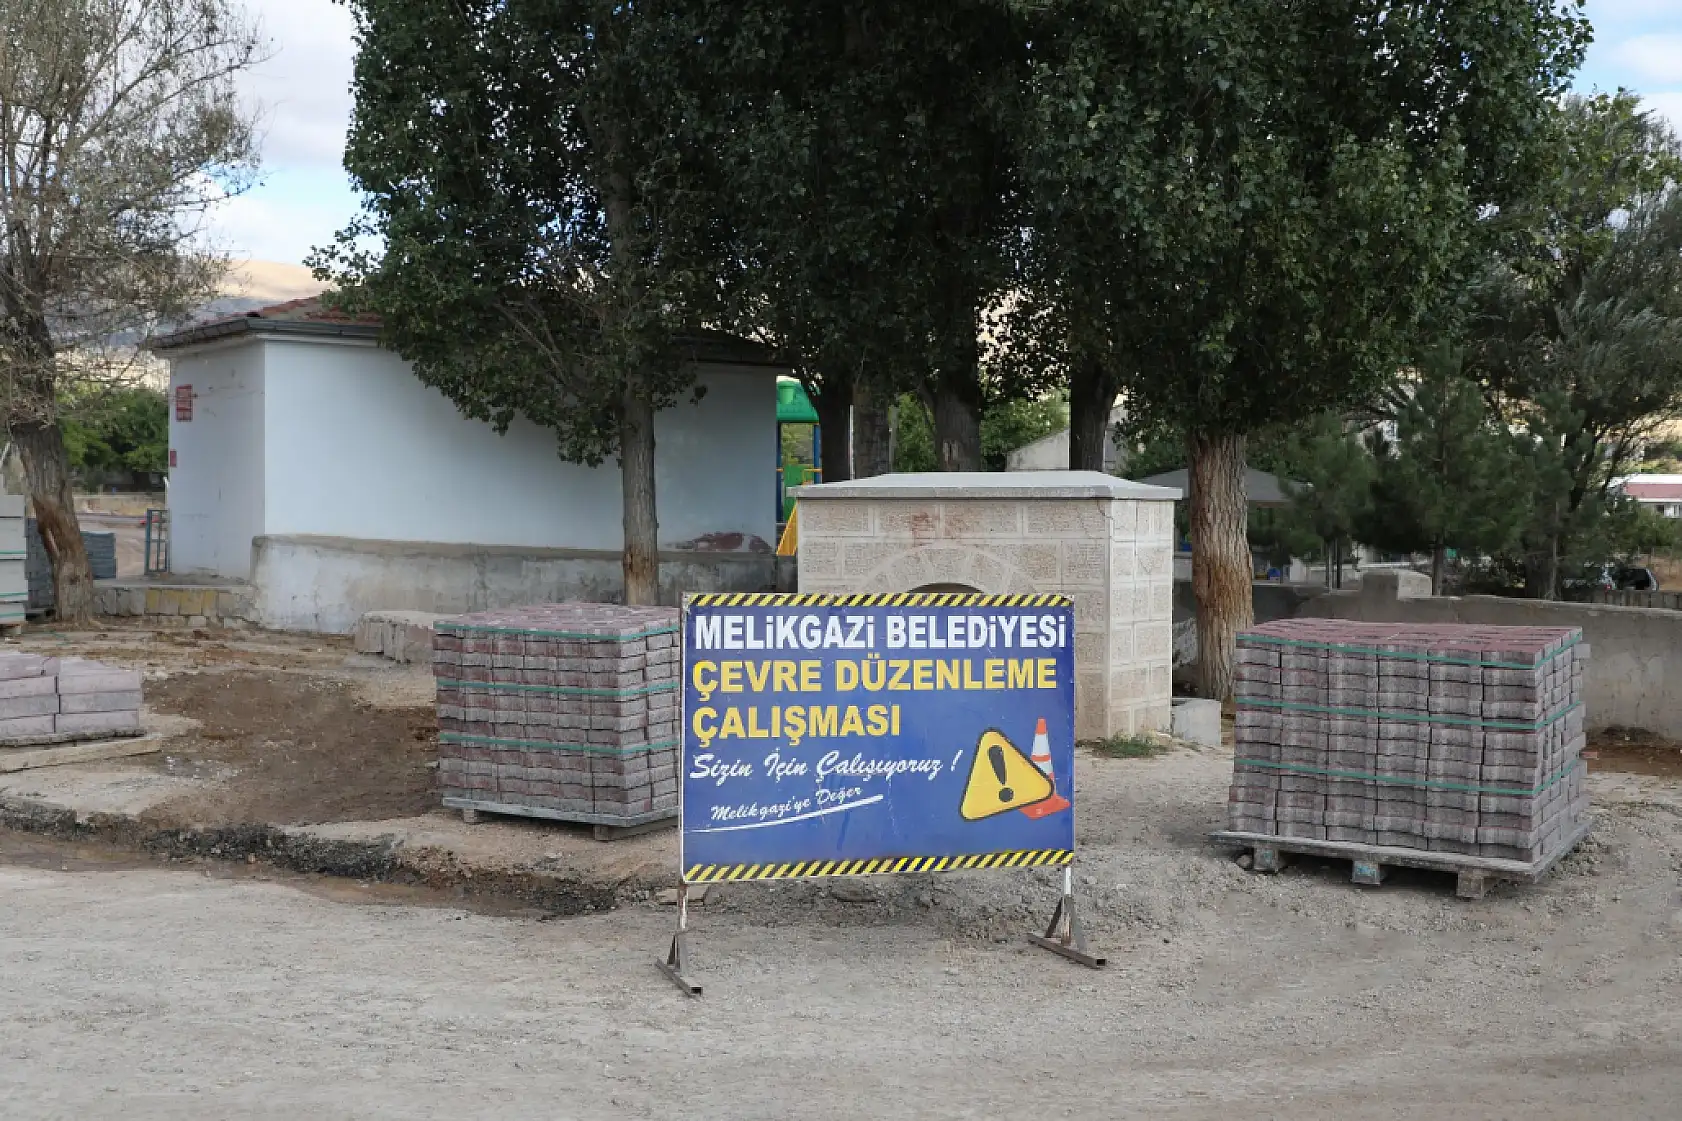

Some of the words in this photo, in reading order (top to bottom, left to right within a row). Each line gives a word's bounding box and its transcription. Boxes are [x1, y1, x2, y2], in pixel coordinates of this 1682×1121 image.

[692, 659, 822, 702] ÇEVRE
[836, 653, 1057, 692] DÜZENLEME
[692, 704, 900, 747] ÇALIŞMASI
[689, 754, 752, 786] Sizin
[815, 750, 943, 782] Çalışıyoruz
[815, 786, 862, 805] Değer
